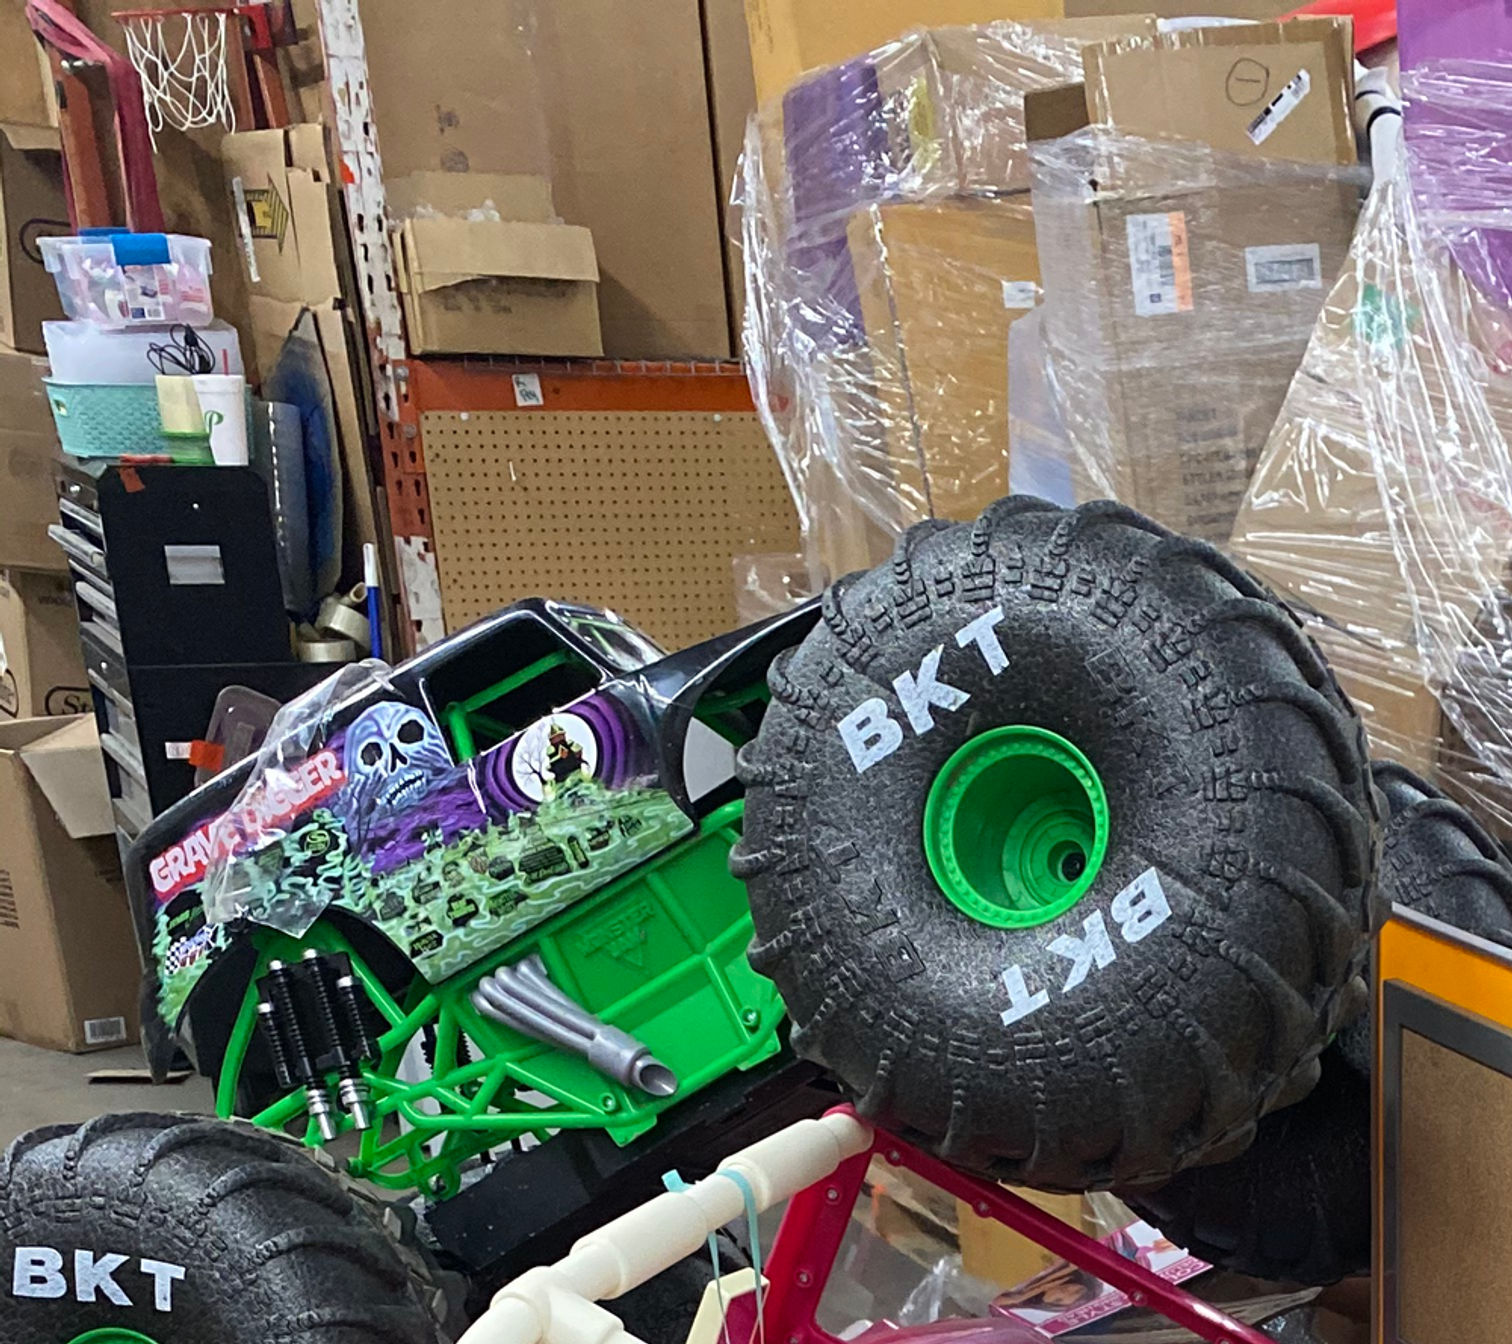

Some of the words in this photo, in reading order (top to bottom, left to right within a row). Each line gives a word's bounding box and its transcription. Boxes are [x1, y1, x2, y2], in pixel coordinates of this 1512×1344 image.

[838, 605, 1010, 773] BKT
[1000, 867, 1172, 1026] BKT
[12, 1246, 186, 1312] BKT
